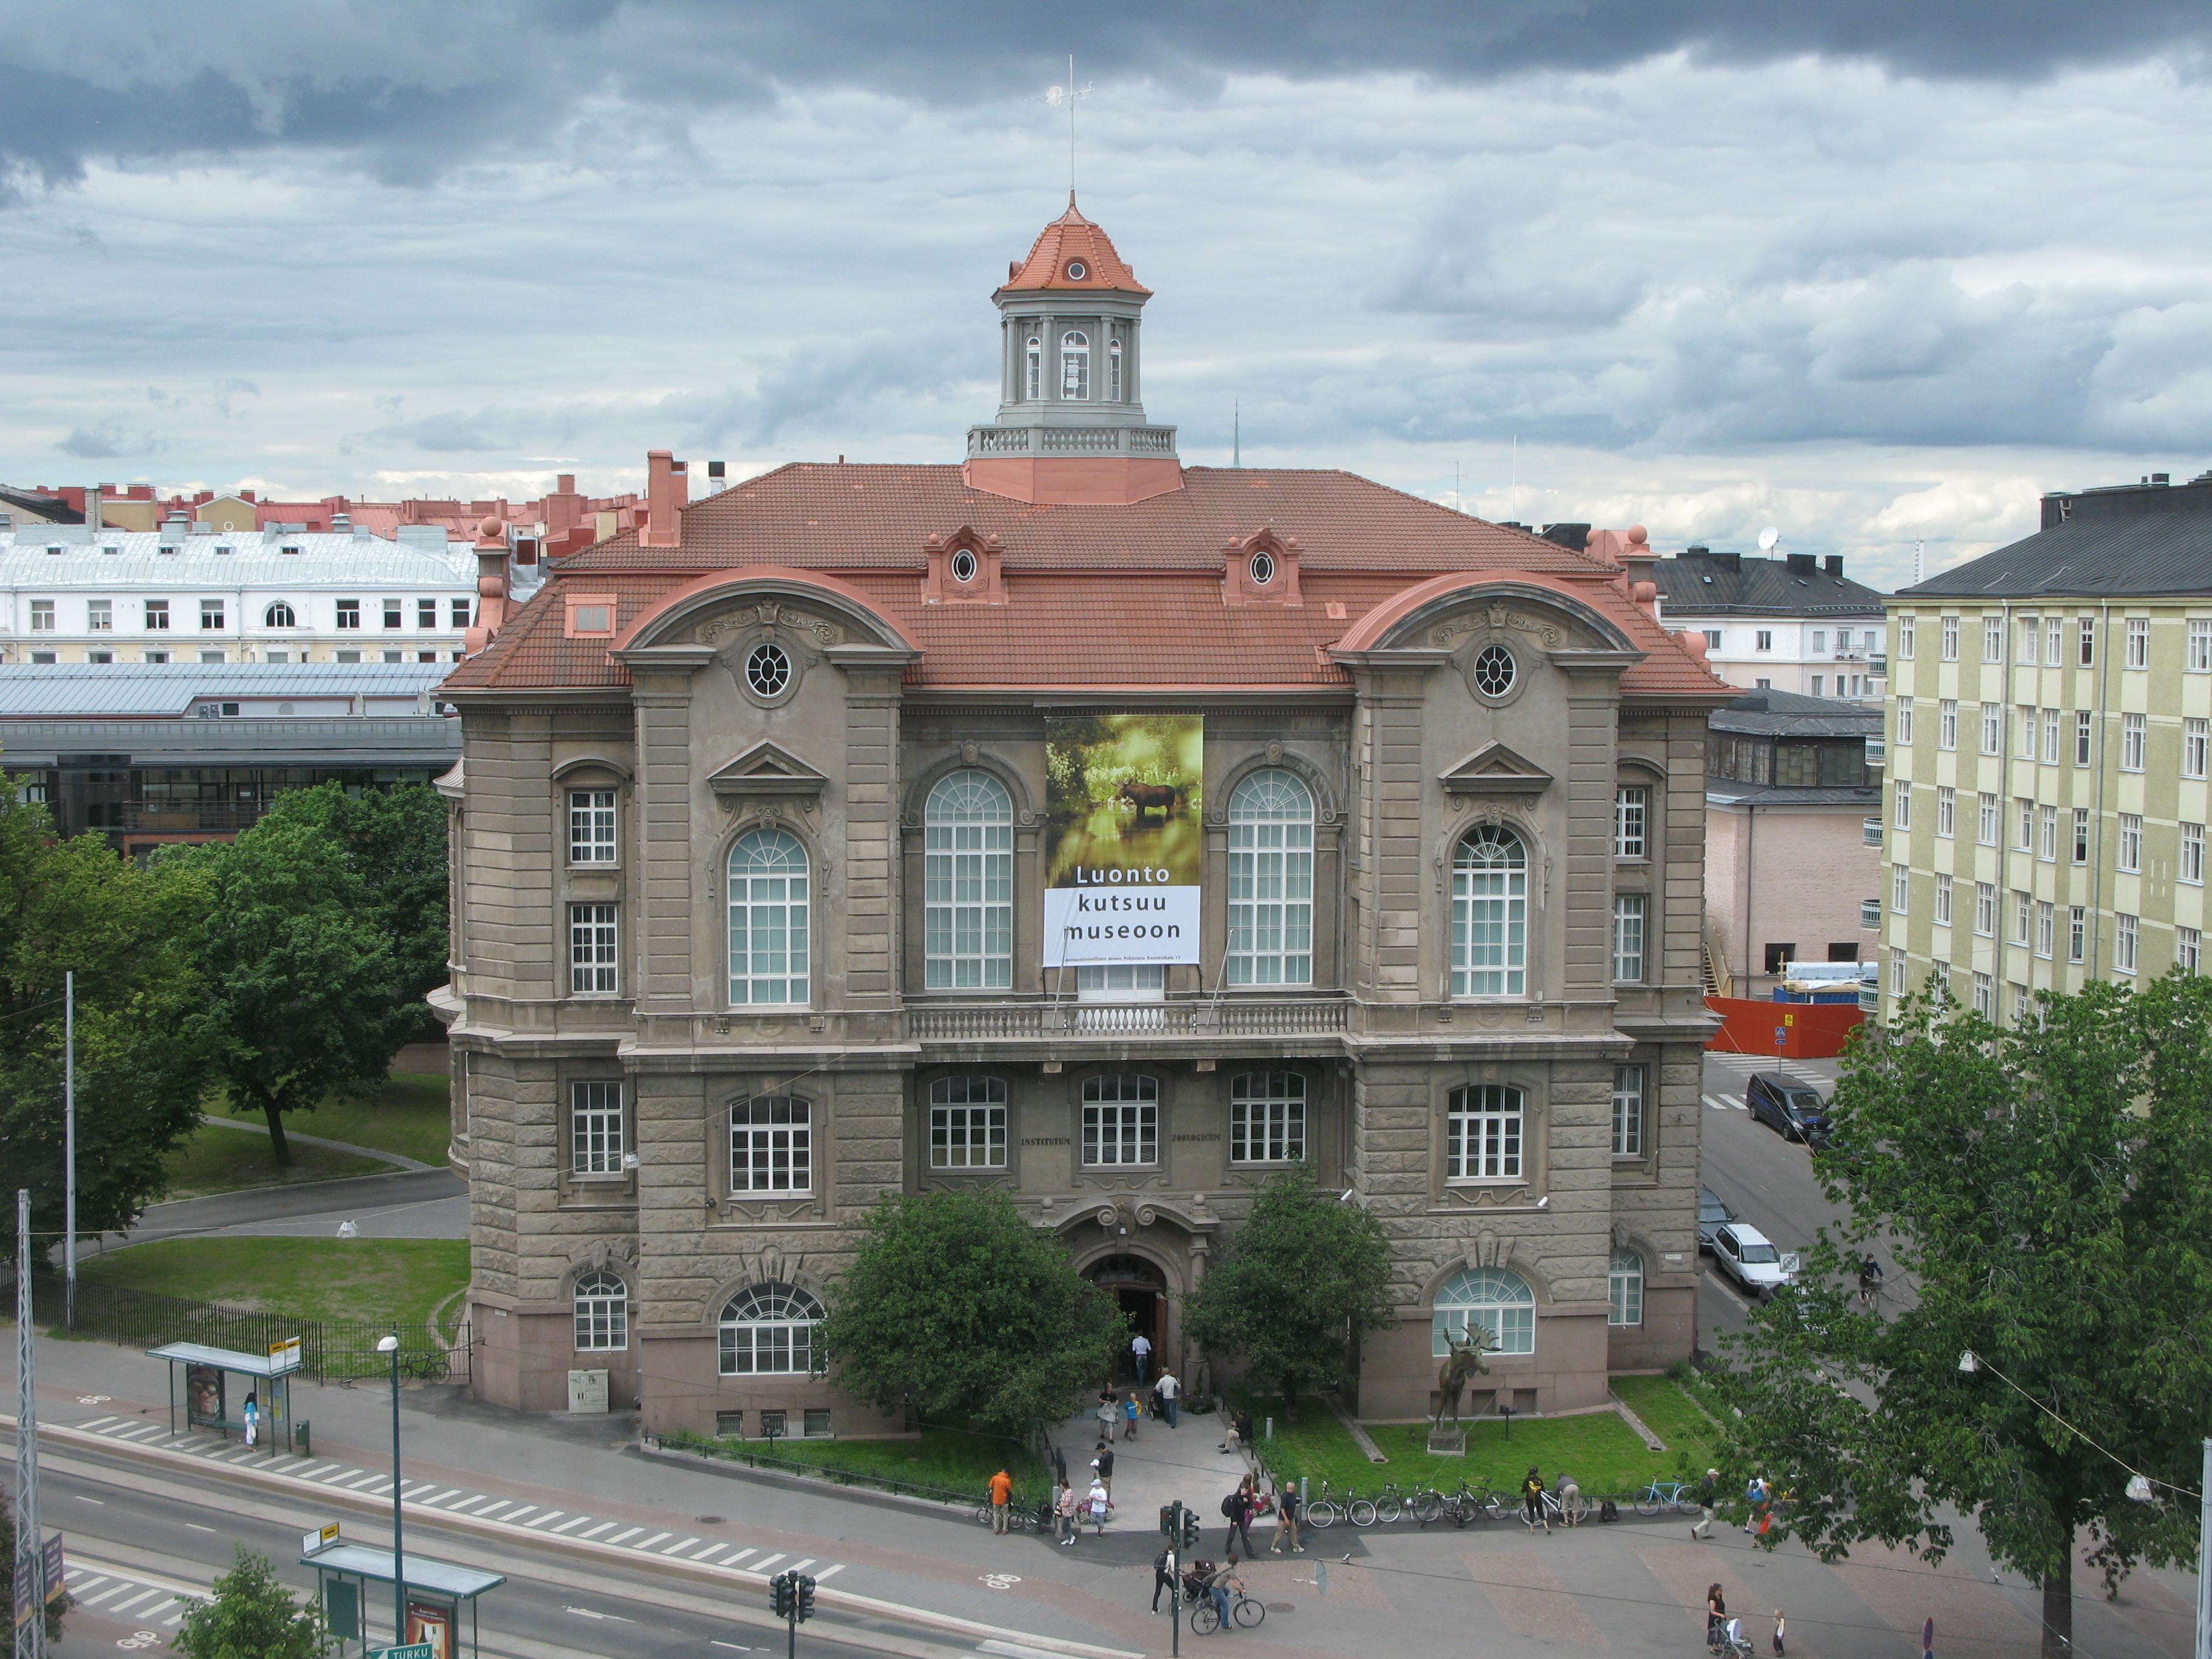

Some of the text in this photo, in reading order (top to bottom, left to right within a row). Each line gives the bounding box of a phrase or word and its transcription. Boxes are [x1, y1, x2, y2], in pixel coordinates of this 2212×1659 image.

[1077, 866, 1170, 883] Luonto
[1079, 894, 1165, 911] kutsuu
[1064, 924, 1180, 939] museoon
[393, 1647, 428, 1659] TURKU
